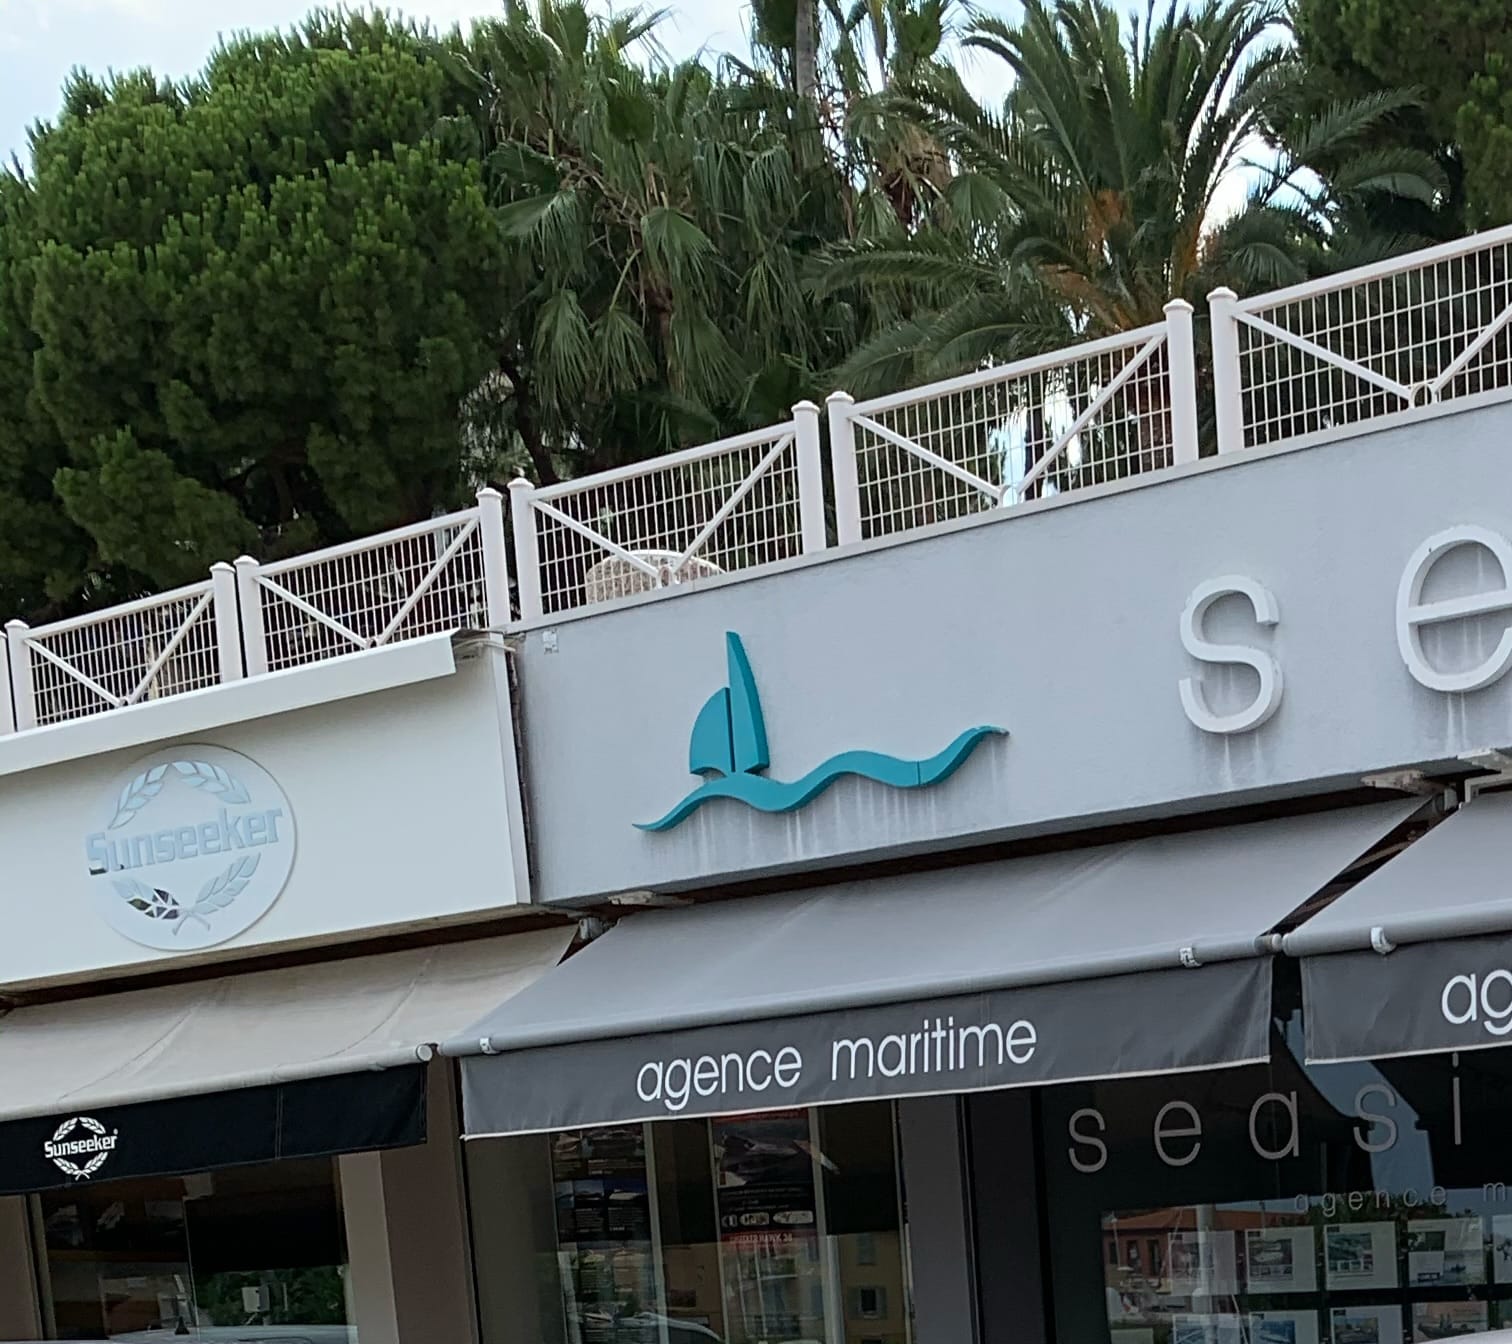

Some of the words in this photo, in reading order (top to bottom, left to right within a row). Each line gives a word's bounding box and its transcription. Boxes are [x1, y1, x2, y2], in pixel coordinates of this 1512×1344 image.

[85, 808, 283, 876] Sunseeker
[636, 1045, 803, 1112] agence
[830, 1016, 1037, 1081] maritime
[44, 1133, 118, 1159] Sunseeker
[1293, 1184, 1449, 1218] agence
